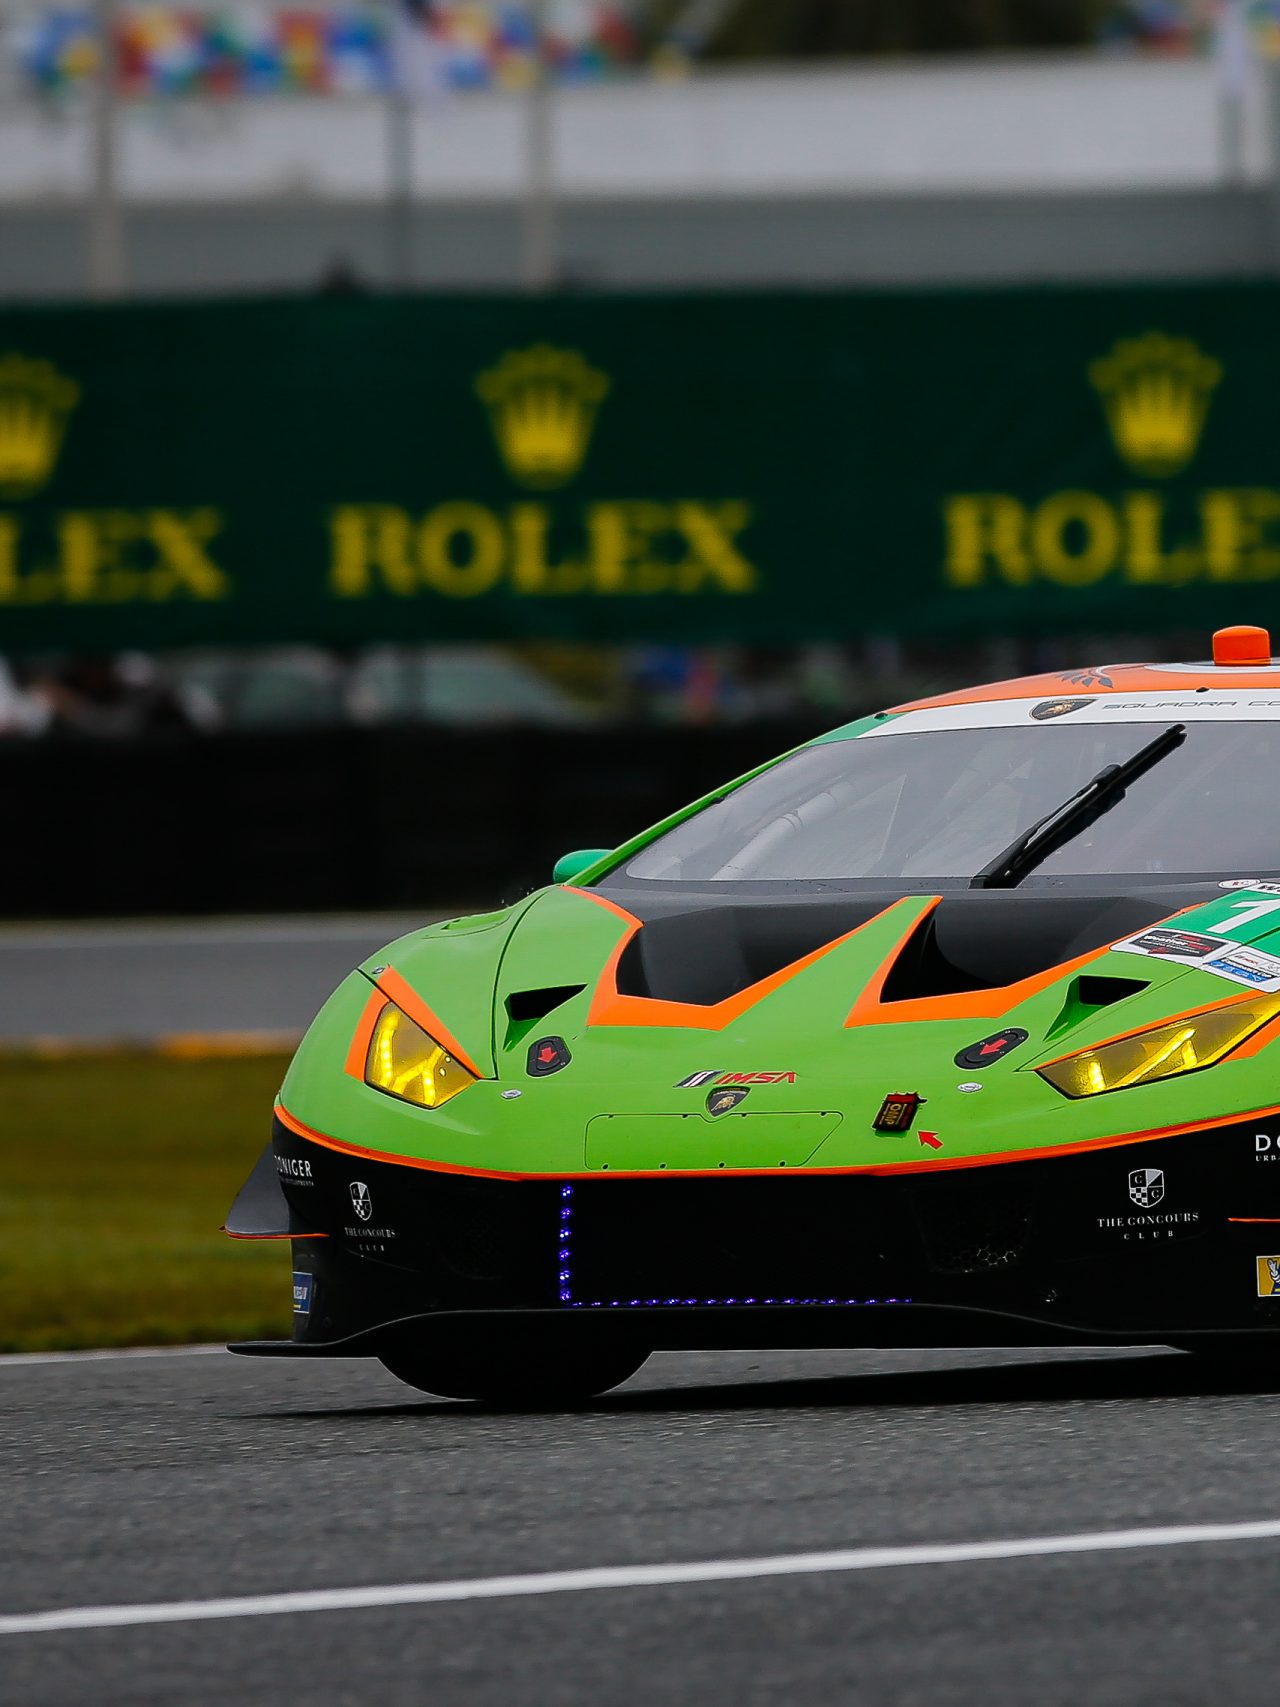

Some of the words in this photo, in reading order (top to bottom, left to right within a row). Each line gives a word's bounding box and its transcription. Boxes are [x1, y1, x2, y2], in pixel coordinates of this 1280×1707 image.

[330, 500, 757, 597] ROLEX
[1101, 700, 1237, 709] SQUADRA
[713, 1071, 797, 1085] IMSA
[1097, 1217, 1125, 1228] THE
[1127, 1212, 1200, 1226] CONCOURS
[1123, 1230, 1174, 1241] CLUB
